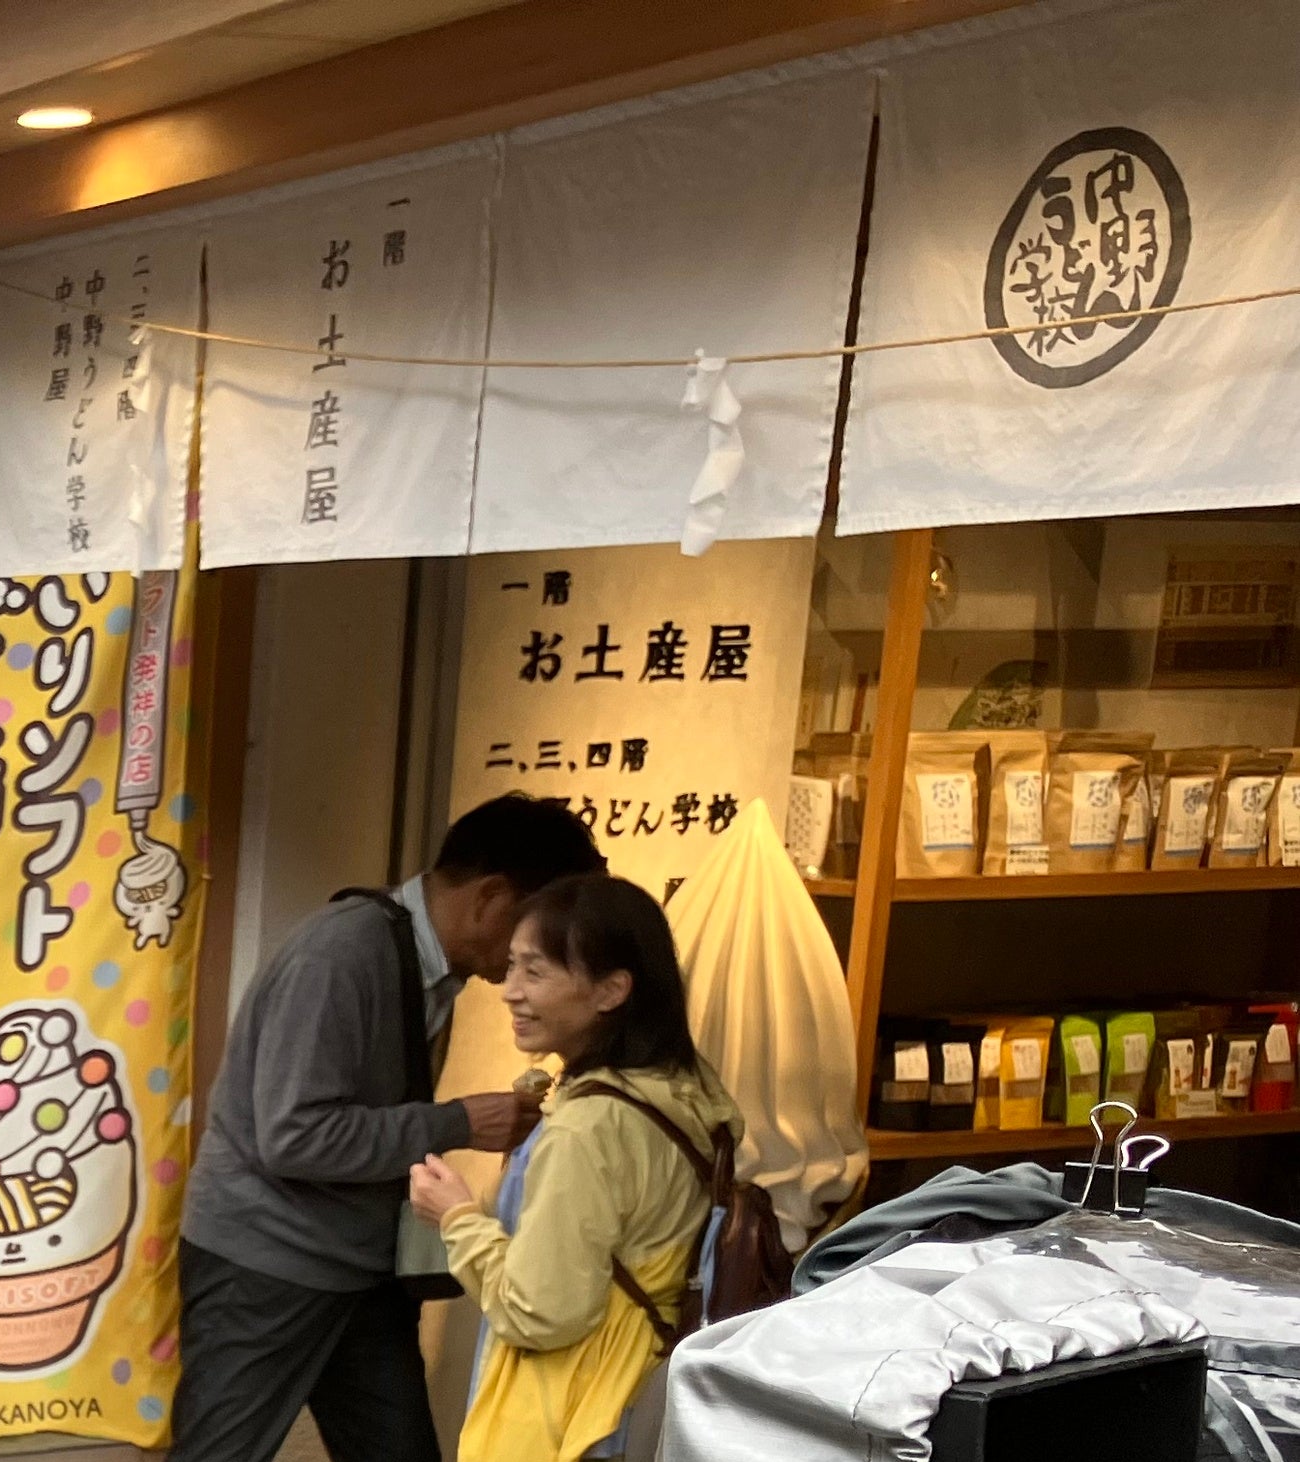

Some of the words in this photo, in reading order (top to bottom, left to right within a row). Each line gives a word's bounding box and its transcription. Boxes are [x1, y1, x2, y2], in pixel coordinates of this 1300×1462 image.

[382, 198, 411, 267] 一階
[45, 275, 74, 402] 中野屋
[65, 269, 107, 553] 中野うどん学校
[300, 240, 352, 525] お土産屋
[502, 570, 573, 606] 一階
[518, 620, 753, 683] お土産屋
[485, 737, 650, 774] 二、三、四階
[550, 793, 740, 837] うどん学校
